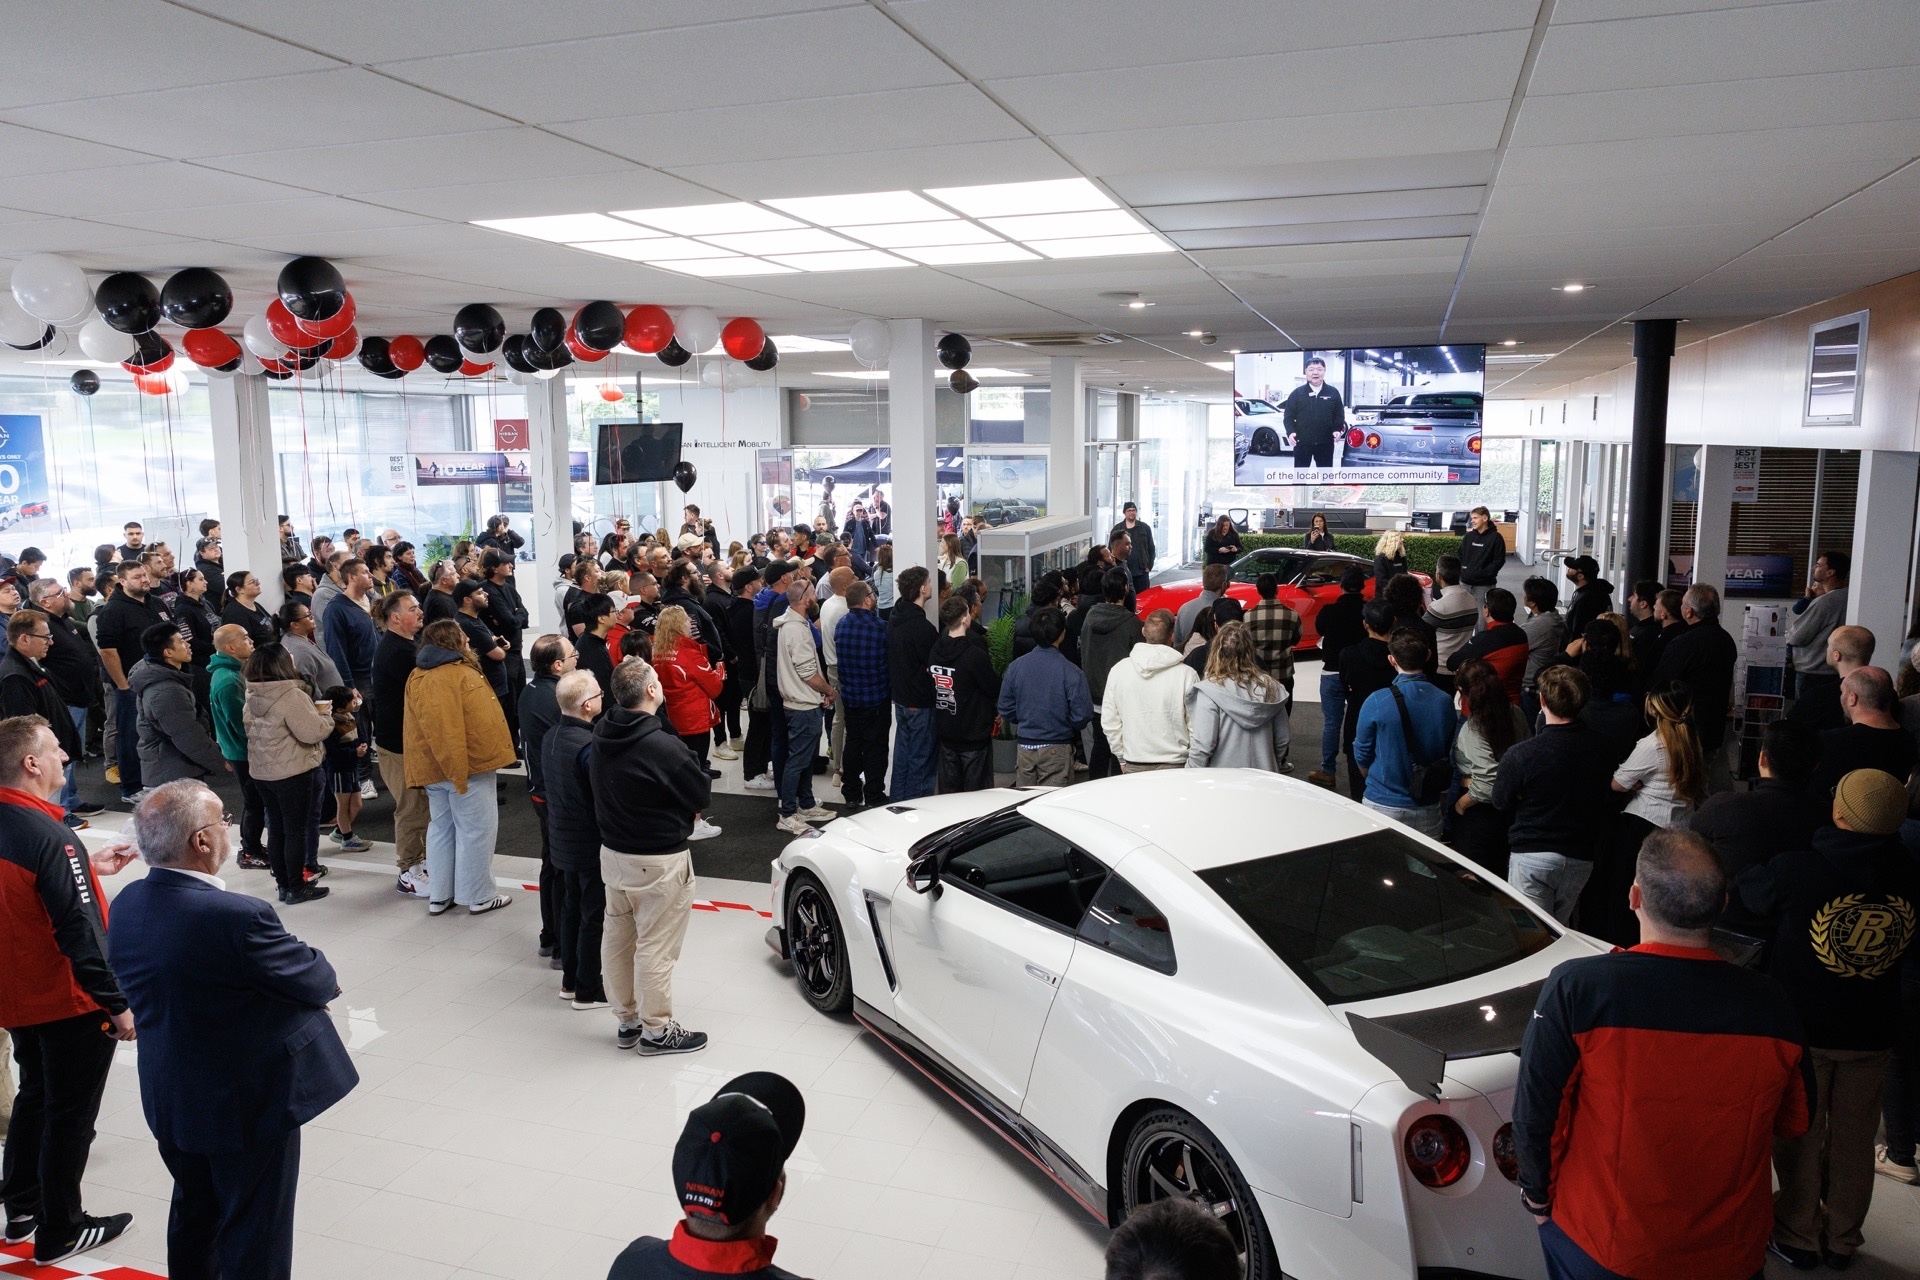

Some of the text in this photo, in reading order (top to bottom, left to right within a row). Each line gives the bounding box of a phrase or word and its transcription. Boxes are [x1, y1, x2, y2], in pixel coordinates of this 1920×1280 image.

[738, 439, 771, 448] MOBILITY
[457, 462, 486, 471] YEAR
[1266, 469, 1445, 482] of the local performance community.
[1725, 568, 1764, 579] YEAR
[930, 664, 956, 677] GT
[685, 1182, 725, 1199] NISSAN
[685, 1193, 722, 1208] nismo
